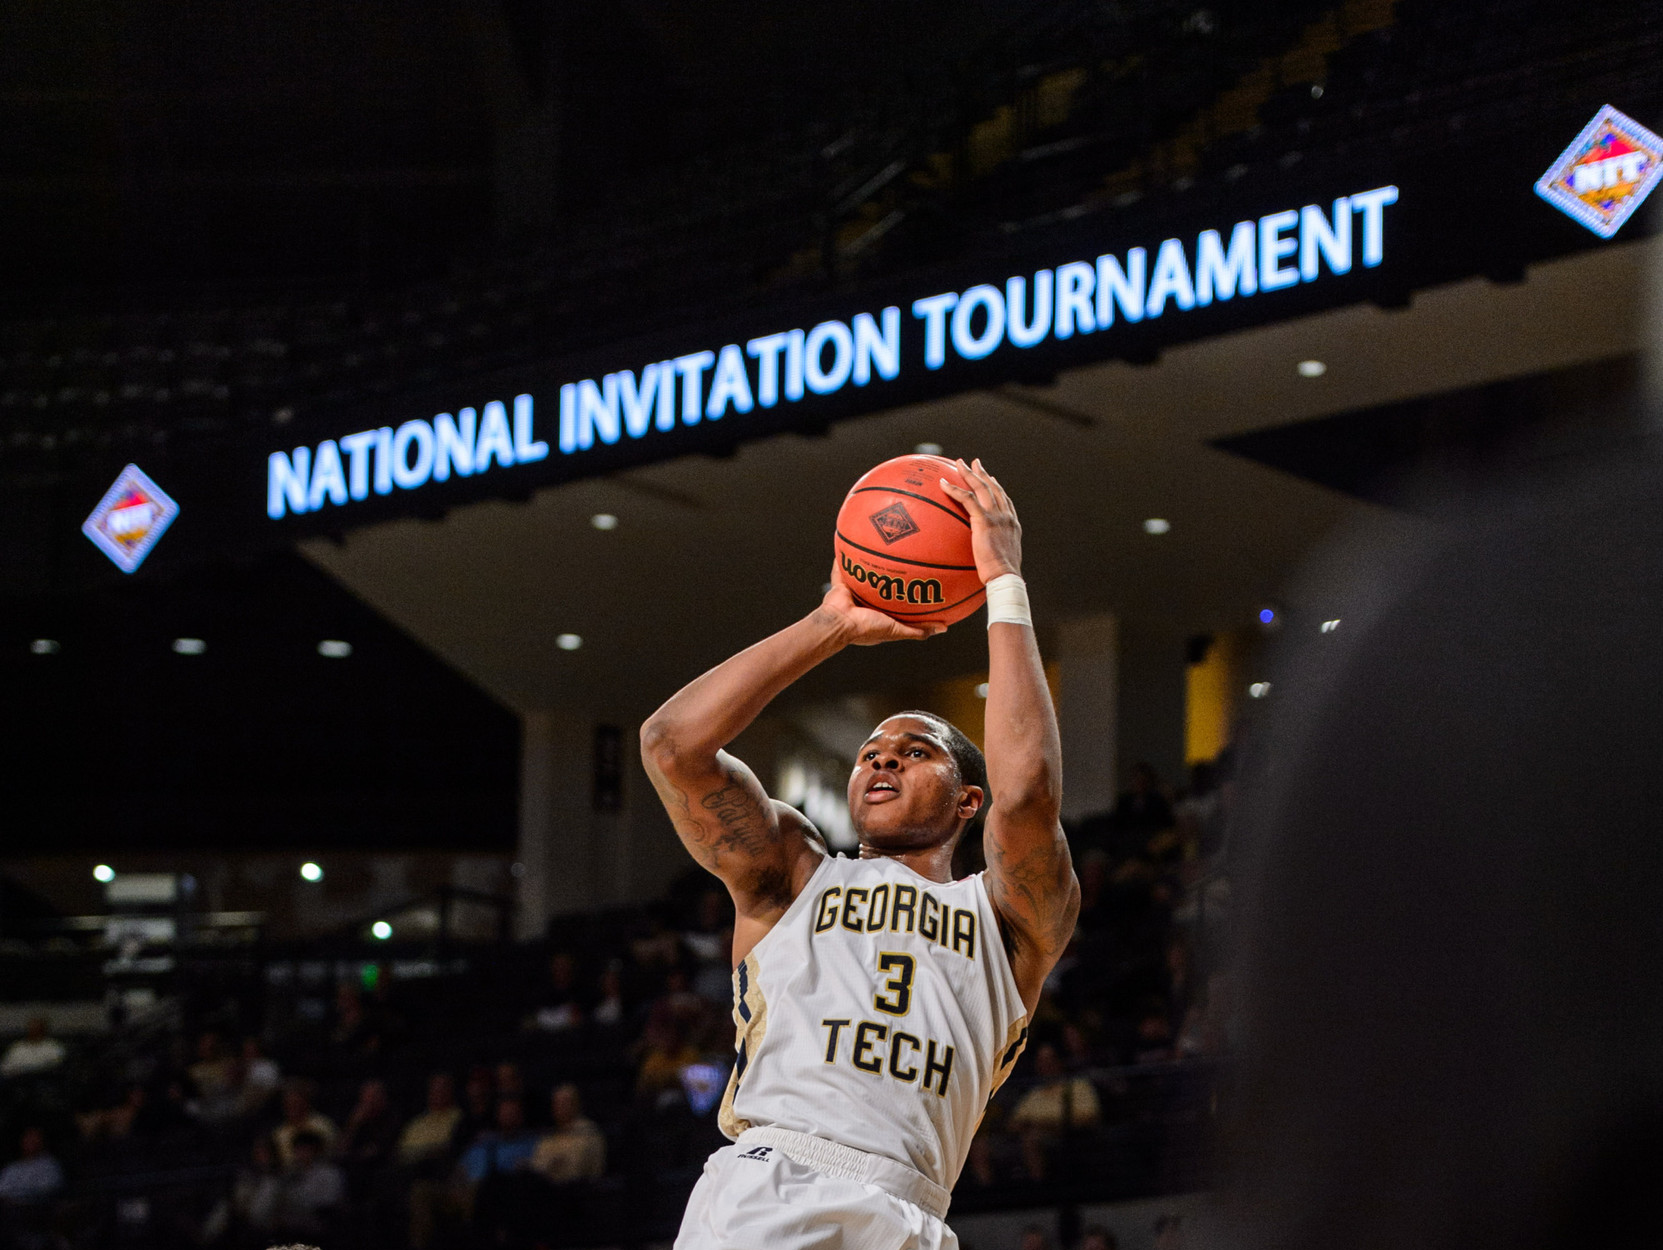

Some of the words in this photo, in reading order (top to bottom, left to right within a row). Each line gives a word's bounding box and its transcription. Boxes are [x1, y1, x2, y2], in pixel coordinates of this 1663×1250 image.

[1575, 150, 1649, 194] NIT
[267, 394, 549, 518] NATIONAL
[558, 304, 901, 452] INVITATION
[912, 184, 1400, 368] TOURNAMENT
[841, 550, 945, 604] Wilson
[815, 883, 977, 961] GEORGIA
[873, 951, 917, 1017] 3
[821, 1018, 955, 1098] TECH
